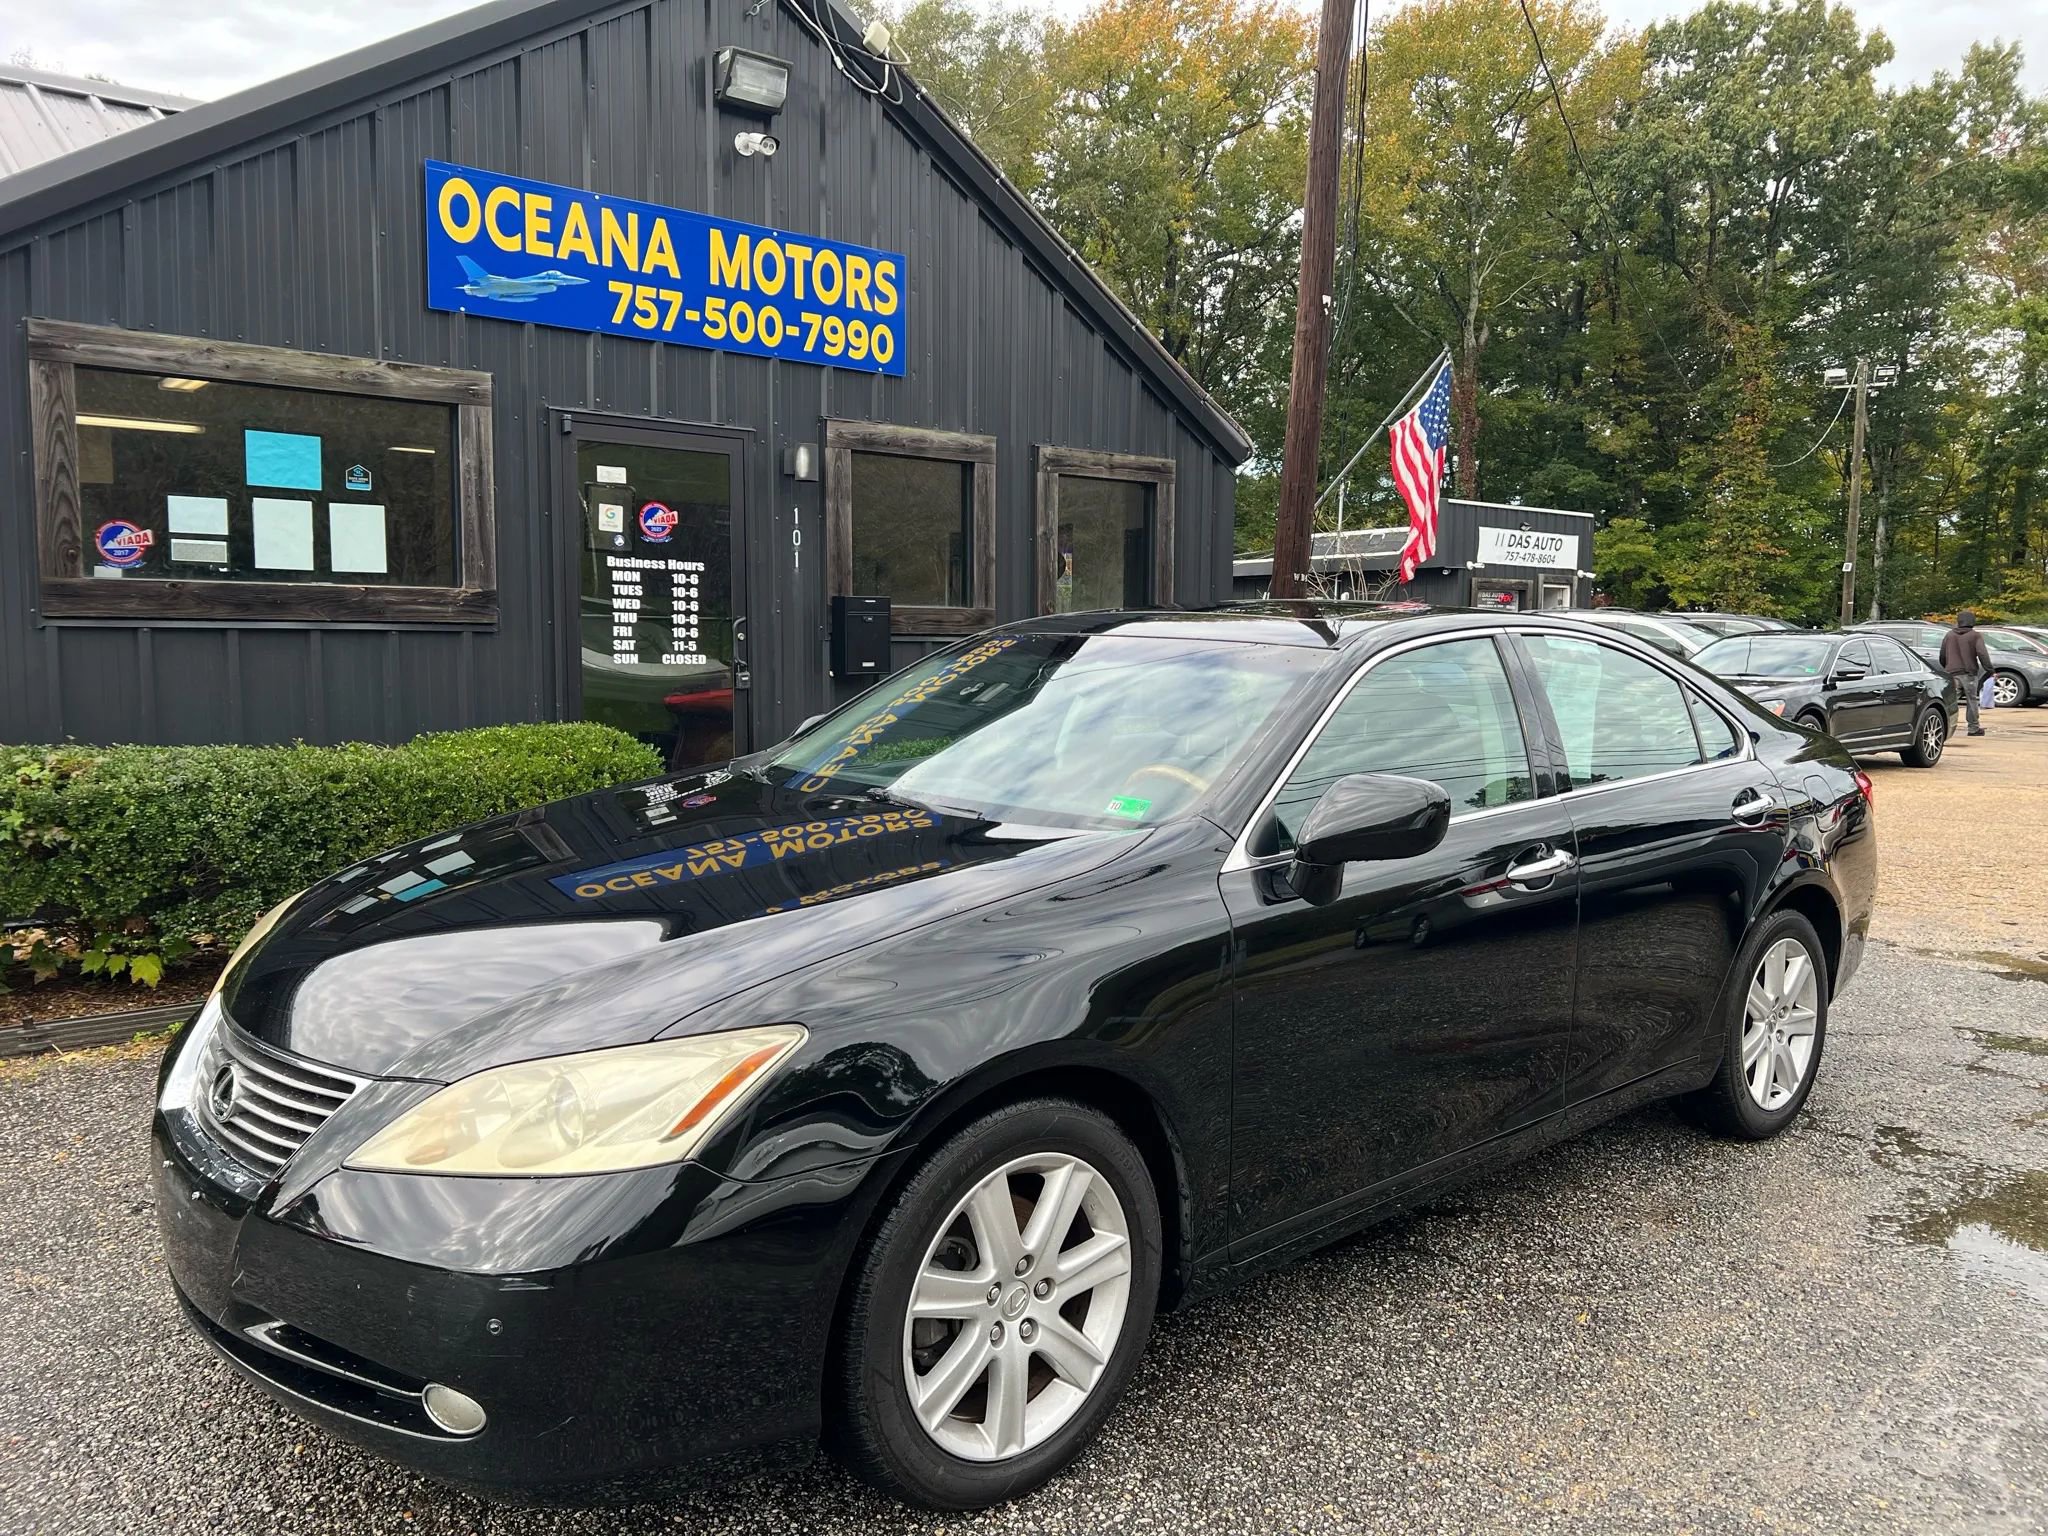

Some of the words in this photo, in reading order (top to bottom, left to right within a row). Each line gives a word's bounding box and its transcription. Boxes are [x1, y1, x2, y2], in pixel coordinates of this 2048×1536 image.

[438, 177, 680, 279] OCEANA
[709, 228, 898, 315] MOTORS
[608, 280, 894, 363] 757-500-7990
[116, 532, 150, 546] VIADA
[1507, 533, 1531, 549] DAS
[1532, 536, 1563, 551] AUTO
[606, 556, 666, 569] Business
[667, 559, 705, 571] Hours
[1504, 551, 1556, 564] 757-478-8604
[612, 570, 641, 582] MON
[671, 573, 699, 584] 10-6
[612, 584, 643, 596] TUES
[671, 587, 699, 598] 10-6
[612, 598, 641, 609] WED
[671, 600, 699, 611] 10-6
[612, 612, 638, 623] THU
[671, 614, 698, 625] 10-6
[612, 626, 633, 637] FRI
[671, 627, 699, 638] 10-6
[613, 640, 636, 651] SAT
[672, 640, 697, 651] 11-5
[613, 653, 639, 664] SUN
[662, 654, 707, 665] CLOSED
